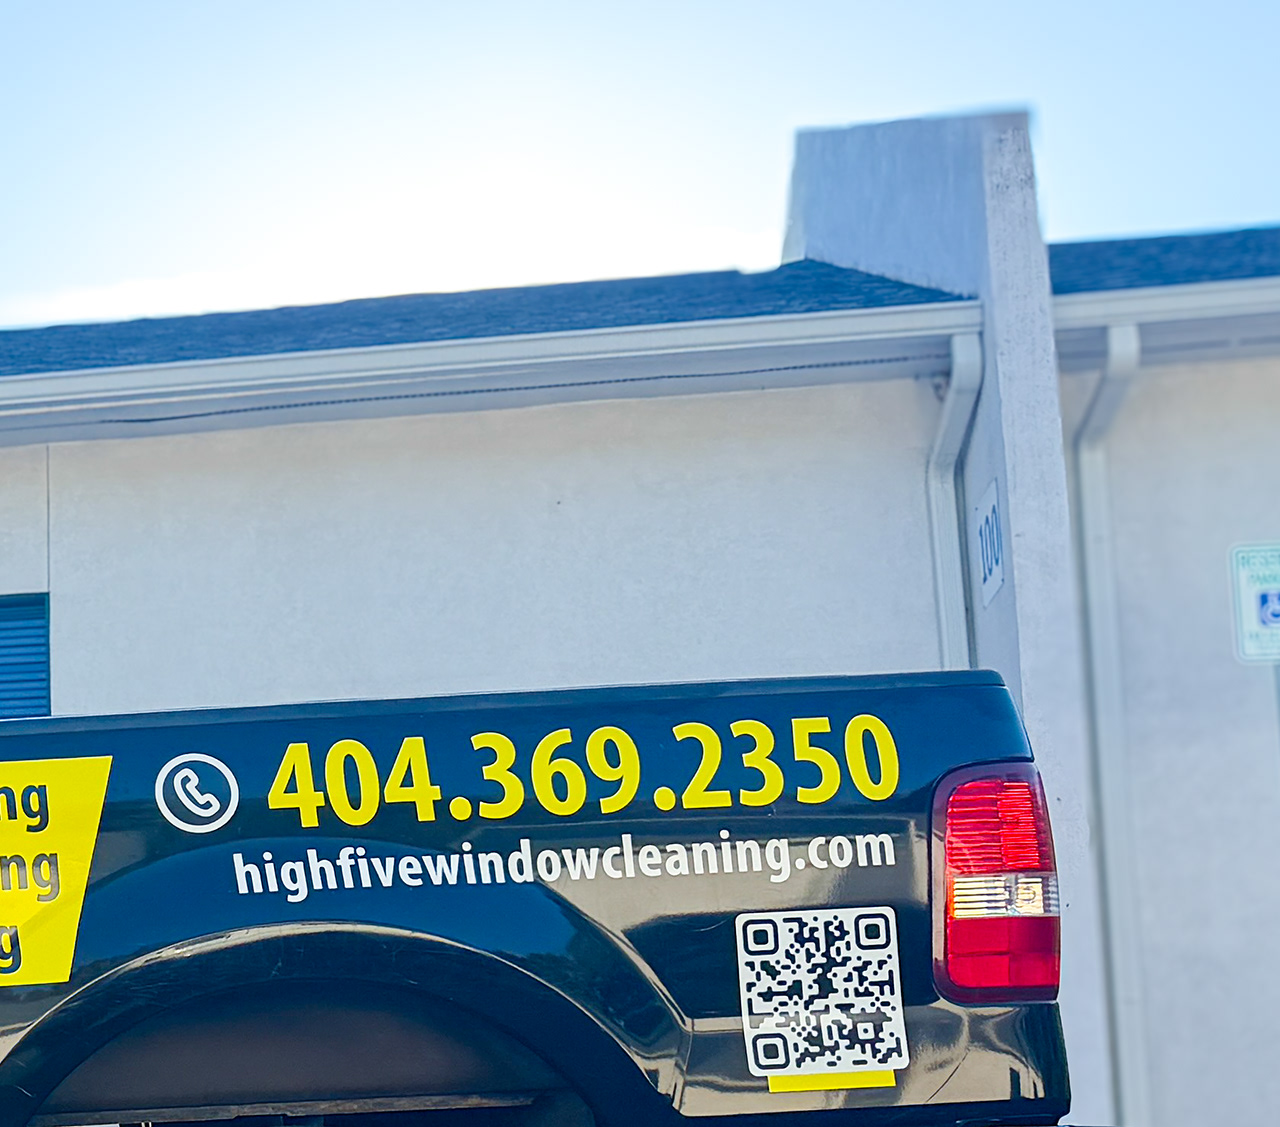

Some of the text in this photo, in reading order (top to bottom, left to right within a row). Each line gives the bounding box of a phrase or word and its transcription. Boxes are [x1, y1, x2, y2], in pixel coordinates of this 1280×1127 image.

[979, 504, 1000, 584] 100
[268, 715, 898, 827] 404.369.2350
[233, 829, 896, 903] highfivewindowcleaning.com
